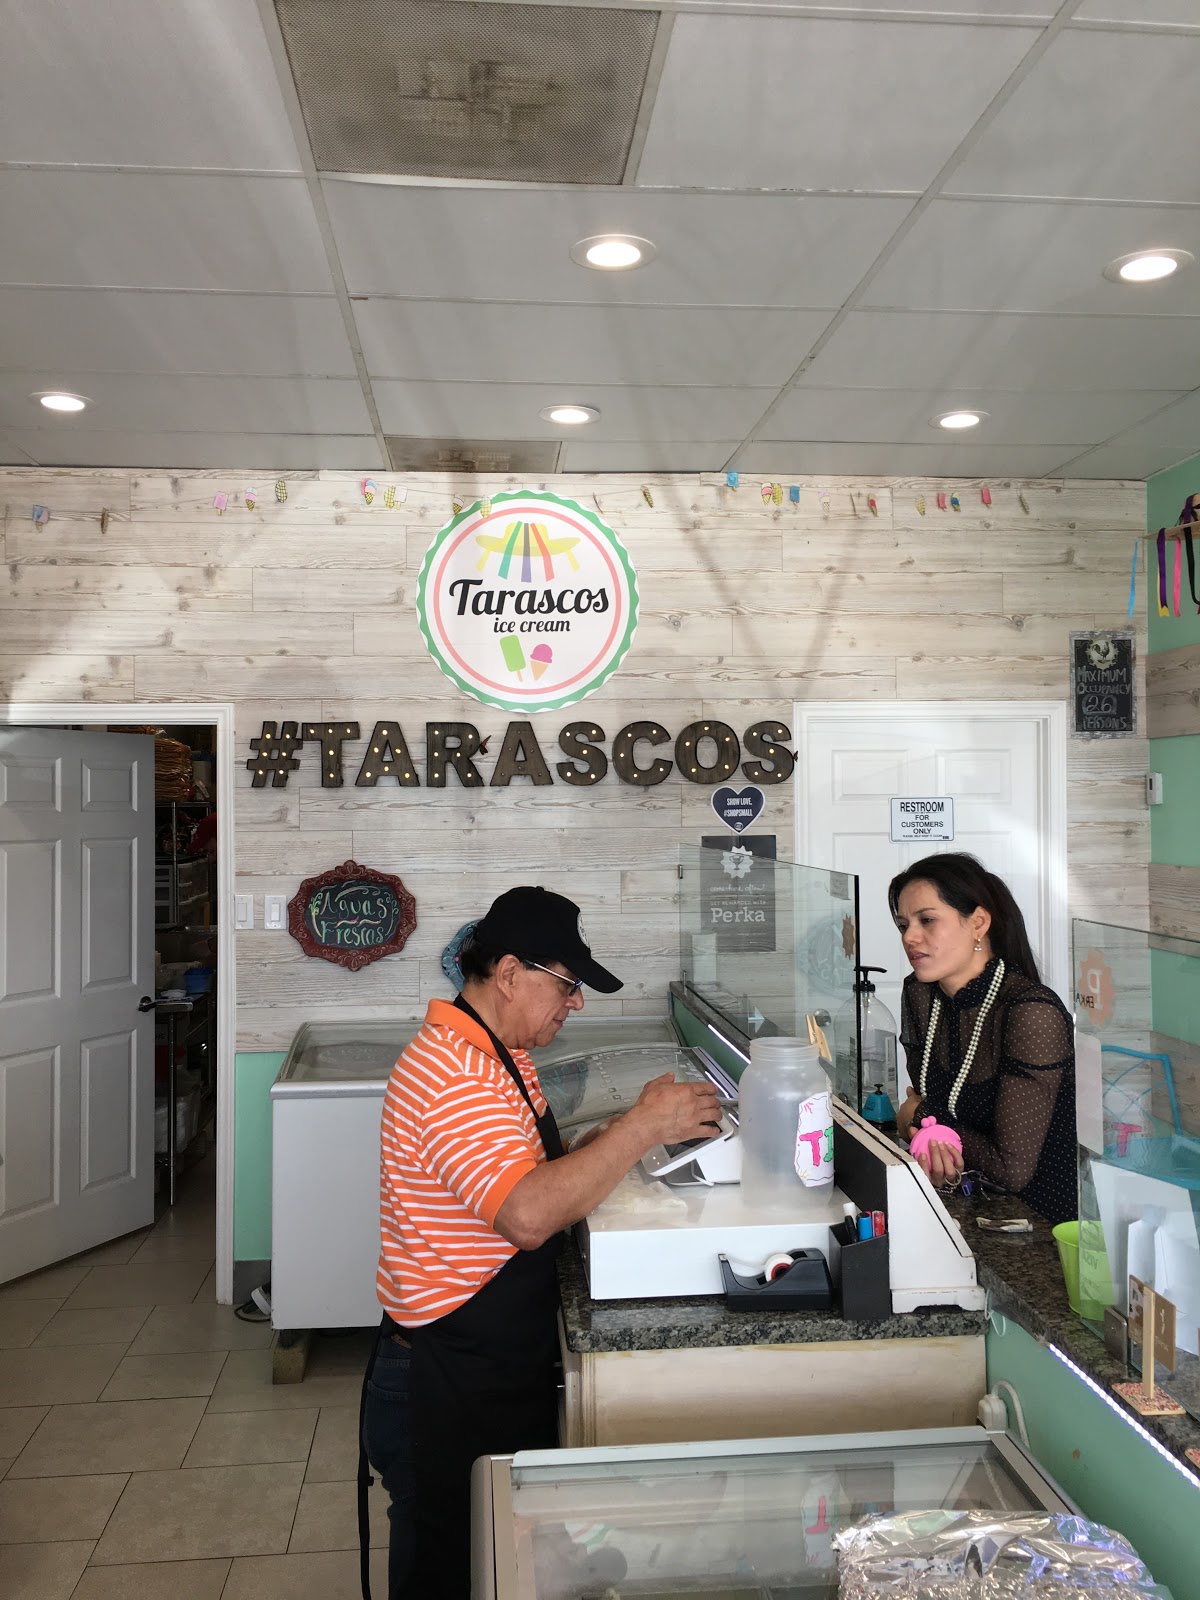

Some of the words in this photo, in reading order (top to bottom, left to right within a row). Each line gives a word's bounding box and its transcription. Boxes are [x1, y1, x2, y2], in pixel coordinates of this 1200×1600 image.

[449, 579, 610, 615] Tarascos
[493, 617, 515, 633] ice
[519, 620, 571, 633] cream
[1086, 695, 1112, 712] 26
[246, 720, 796, 788] #TARASCOS
[726, 797, 740, 806] SHOW
[900, 802, 944, 812] RESTROOM
[723, 809, 754, 817] #SHOPSMALL
[319, 891, 388, 919] Aguas
[710, 906, 766, 923] Perka
